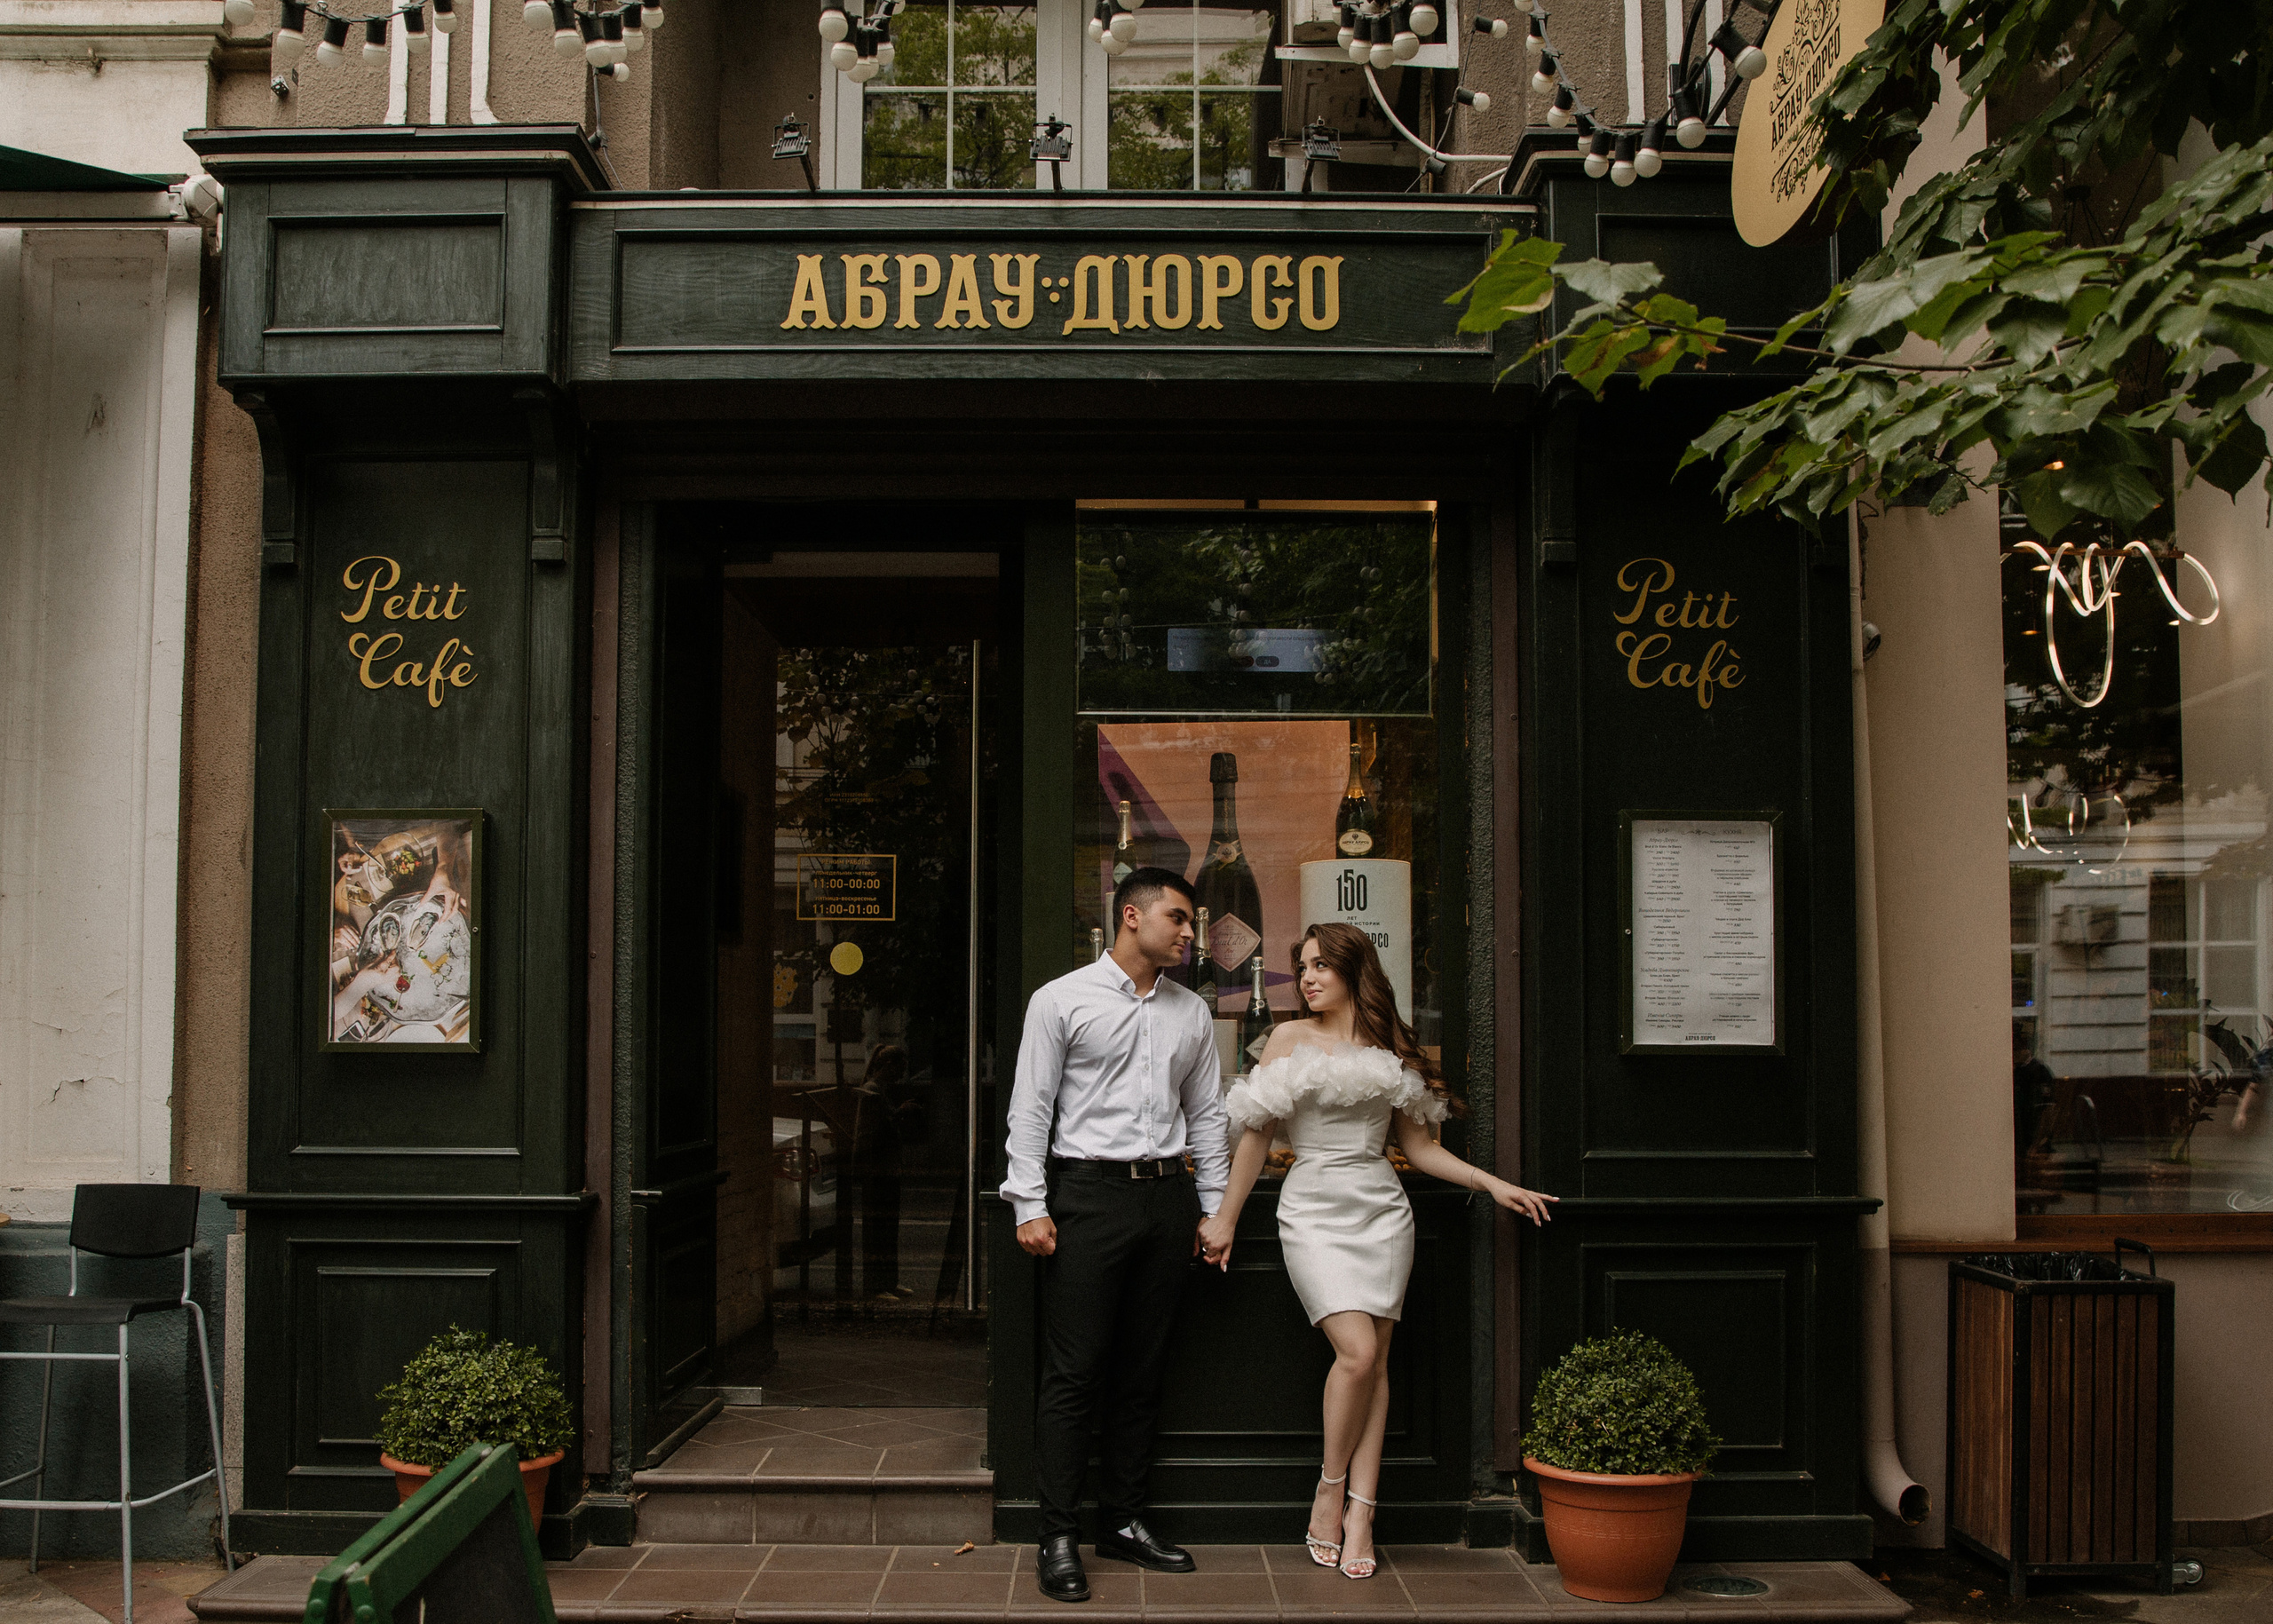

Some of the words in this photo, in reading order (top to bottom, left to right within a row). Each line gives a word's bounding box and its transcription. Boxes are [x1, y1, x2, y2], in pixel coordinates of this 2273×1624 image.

[340, 555, 468, 623] Petit
[1612, 558, 1739, 629] Petit
[348, 632, 479, 708] Cafè
[1615, 630, 1746, 709] Cafè
[812, 904, 880, 915] 11:00-01:00
[813, 878, 880, 889] 11:00-00:00
[1336, 869, 1367, 911] 150
